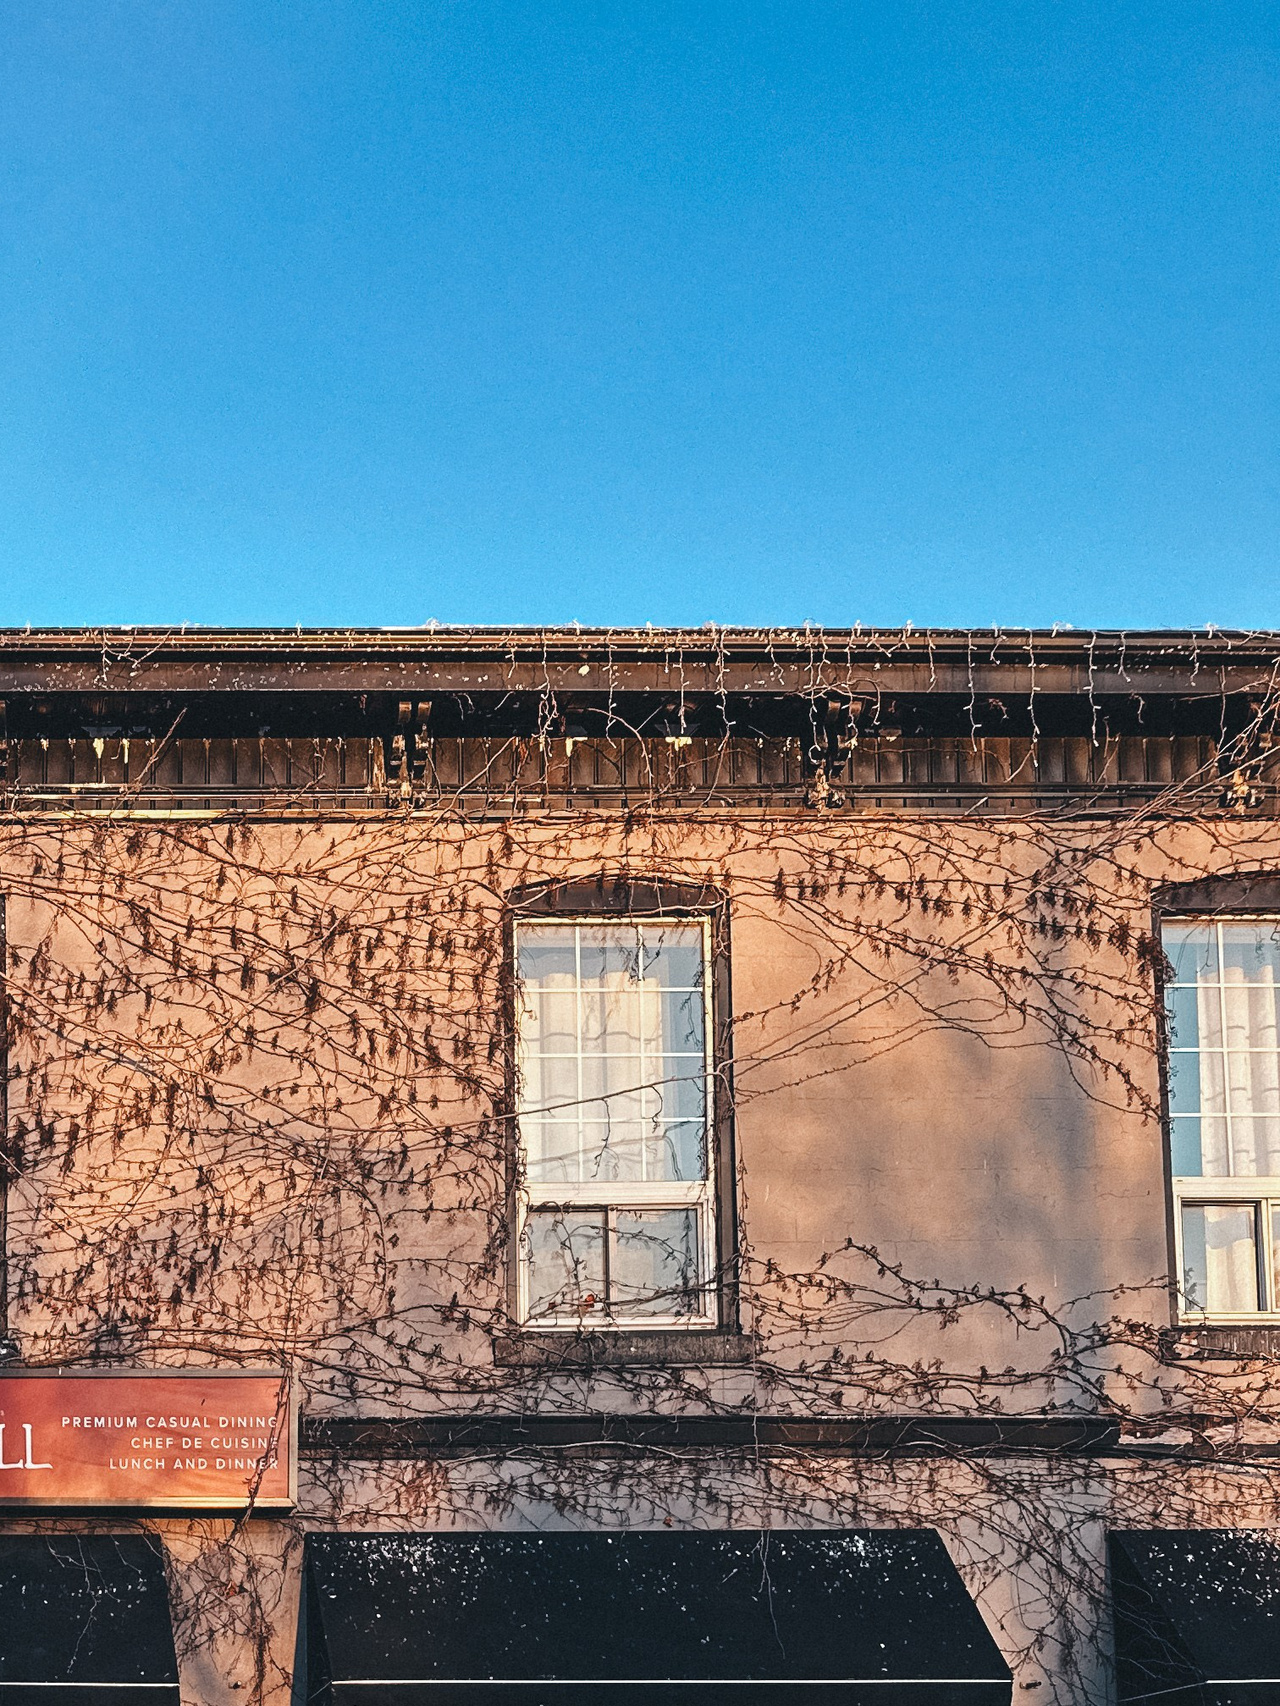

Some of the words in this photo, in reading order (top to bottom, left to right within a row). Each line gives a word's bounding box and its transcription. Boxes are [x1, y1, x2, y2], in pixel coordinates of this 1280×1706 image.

[62, 1416, 138, 1428] PREMIUM
[146, 1416, 211, 1428] CASUAL
[219, 1416, 278, 1428] DINING
[131, 1437, 174, 1449] CHEF
[182, 1437, 202, 1449] DE
[109, 1458, 165, 1470] LUNCH
[173, 1458, 208, 1470] AND
[216, 1458, 279, 1470] DINNER
